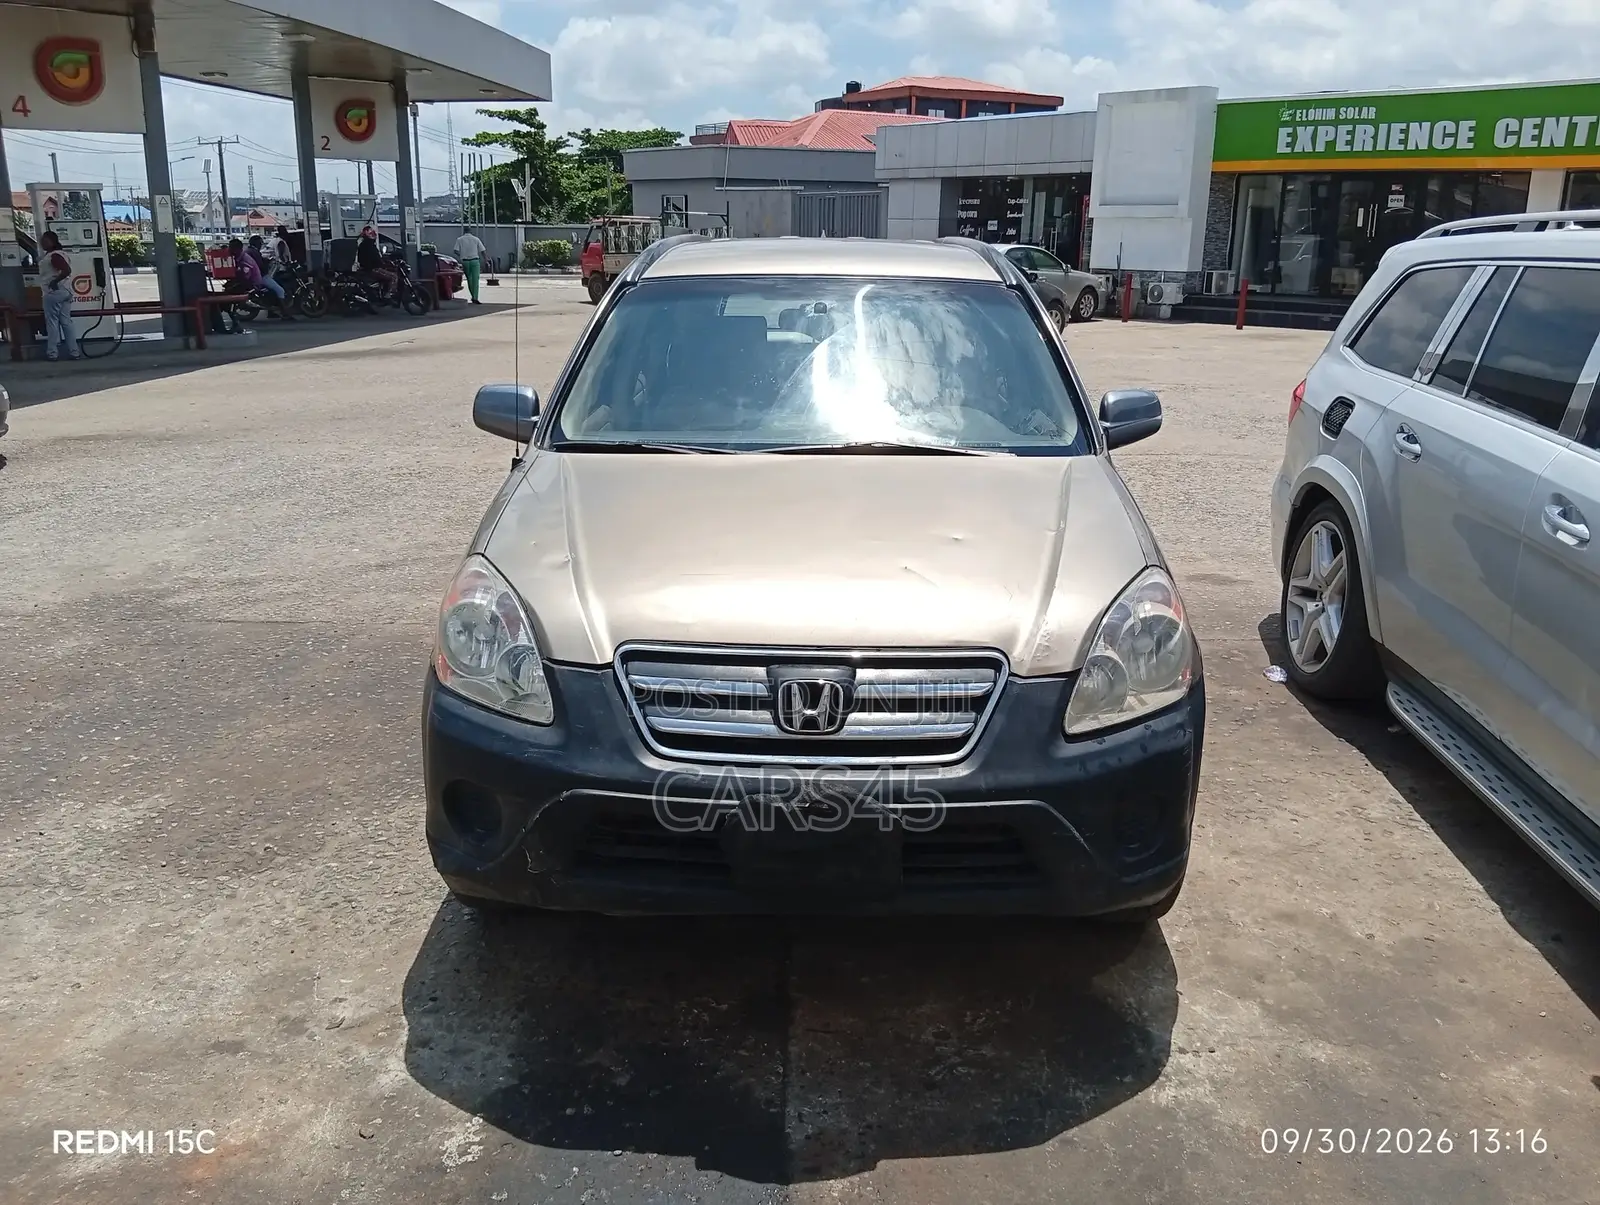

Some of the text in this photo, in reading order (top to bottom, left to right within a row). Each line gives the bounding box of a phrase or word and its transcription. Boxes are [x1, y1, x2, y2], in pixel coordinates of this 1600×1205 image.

[12, 95, 32, 118] 4
[1295, 106, 1376, 121] ELOHIM SOLAR
[321, 135, 331, 151] 2
[1276, 115, 1600, 154] EXPERIENCE CENT
